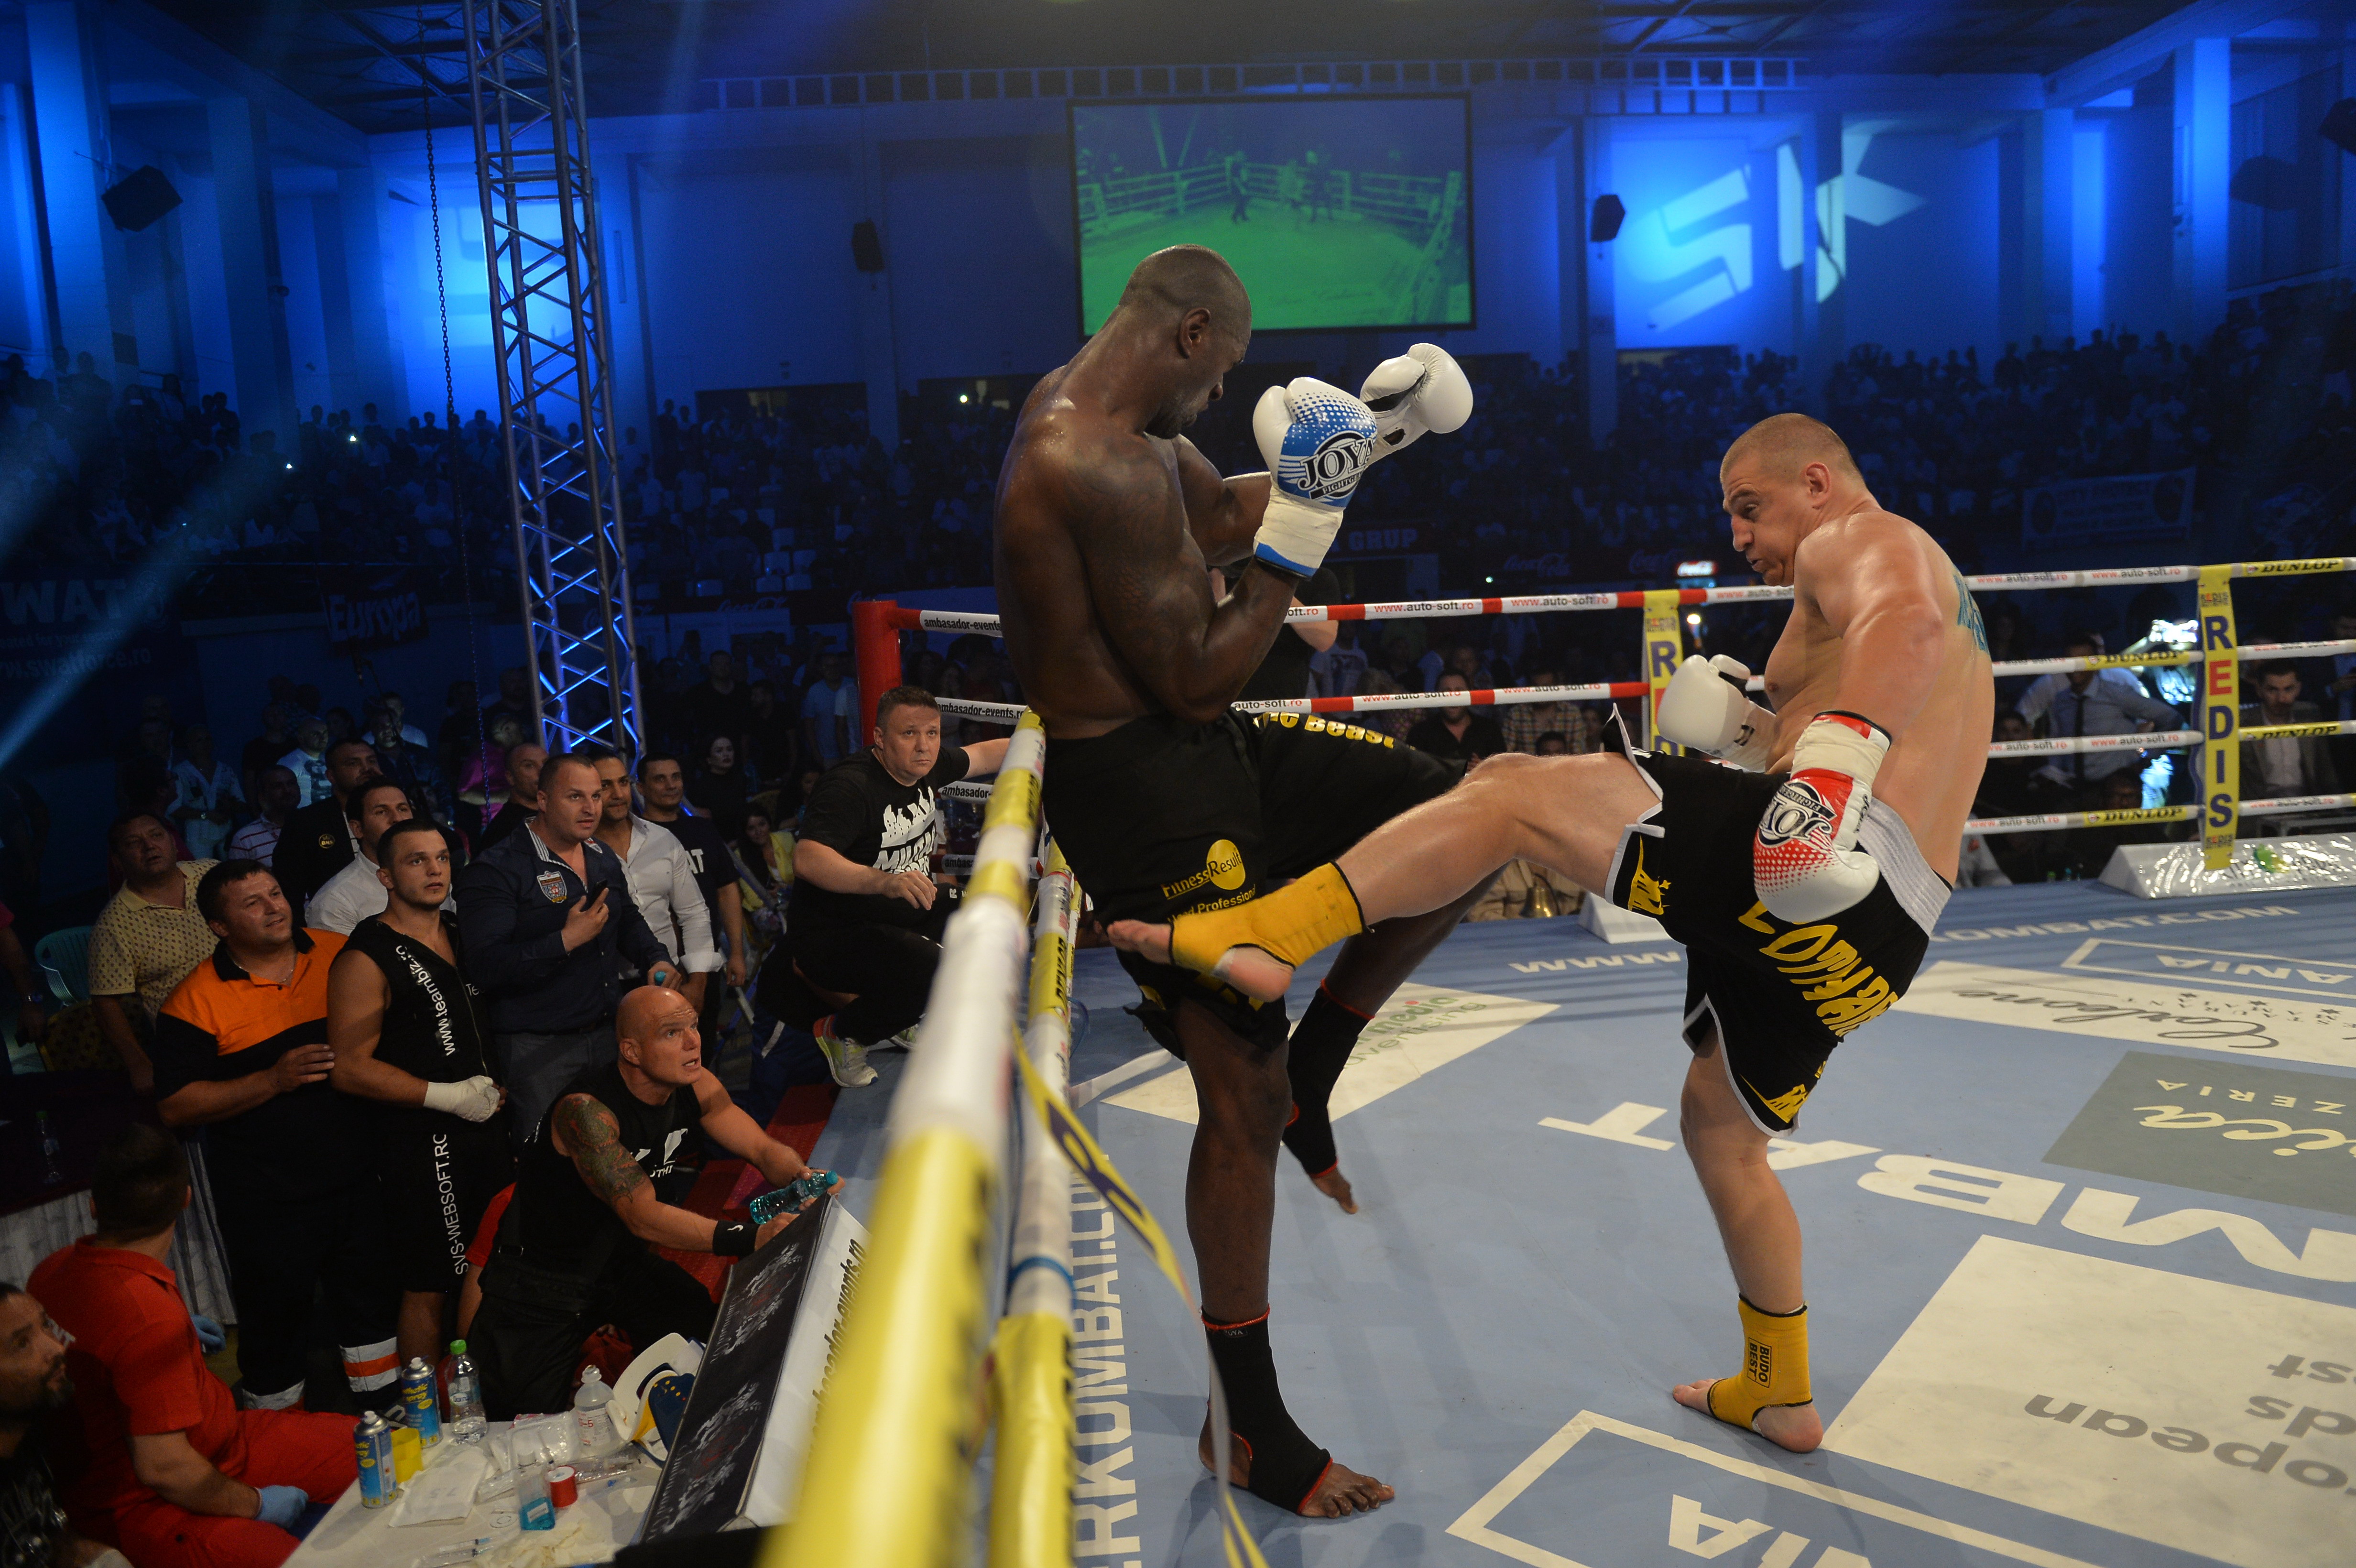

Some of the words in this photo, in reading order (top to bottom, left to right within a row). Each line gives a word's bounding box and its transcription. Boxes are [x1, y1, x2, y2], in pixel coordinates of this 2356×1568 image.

[1348, 528, 1418, 551] GRUP
[328, 591, 422, 642] Europa
[1285, 607, 1319, 617] oft.ro
[1374, 601, 1474, 613] www.auto-soft.ro
[1511, 594, 1609, 607] www.auto-soft.ro
[2204, 615, 2234, 828] REDIS
[1758, 798, 1833, 842] JOY
[2104, 807, 2184, 822] DUNLOP
[1508, 951, 1681, 974] WWW
[2155, 954, 2354, 985] ANIA
[1365, 996, 1459, 1034] media
[1951, 989, 2280, 1050] Corleone
[1344, 1002, 1487, 1067] dvertising
[2155, 1078, 2346, 1114] ZERIA
[2133, 1104, 2356, 1157] ica
[1749, 1342, 1758, 1380] BEST
[1759, 1346, 1769, 1383] BUDO
[2266, 1354, 2356, 1384] st
[2023, 1394, 2356, 1497] opean
